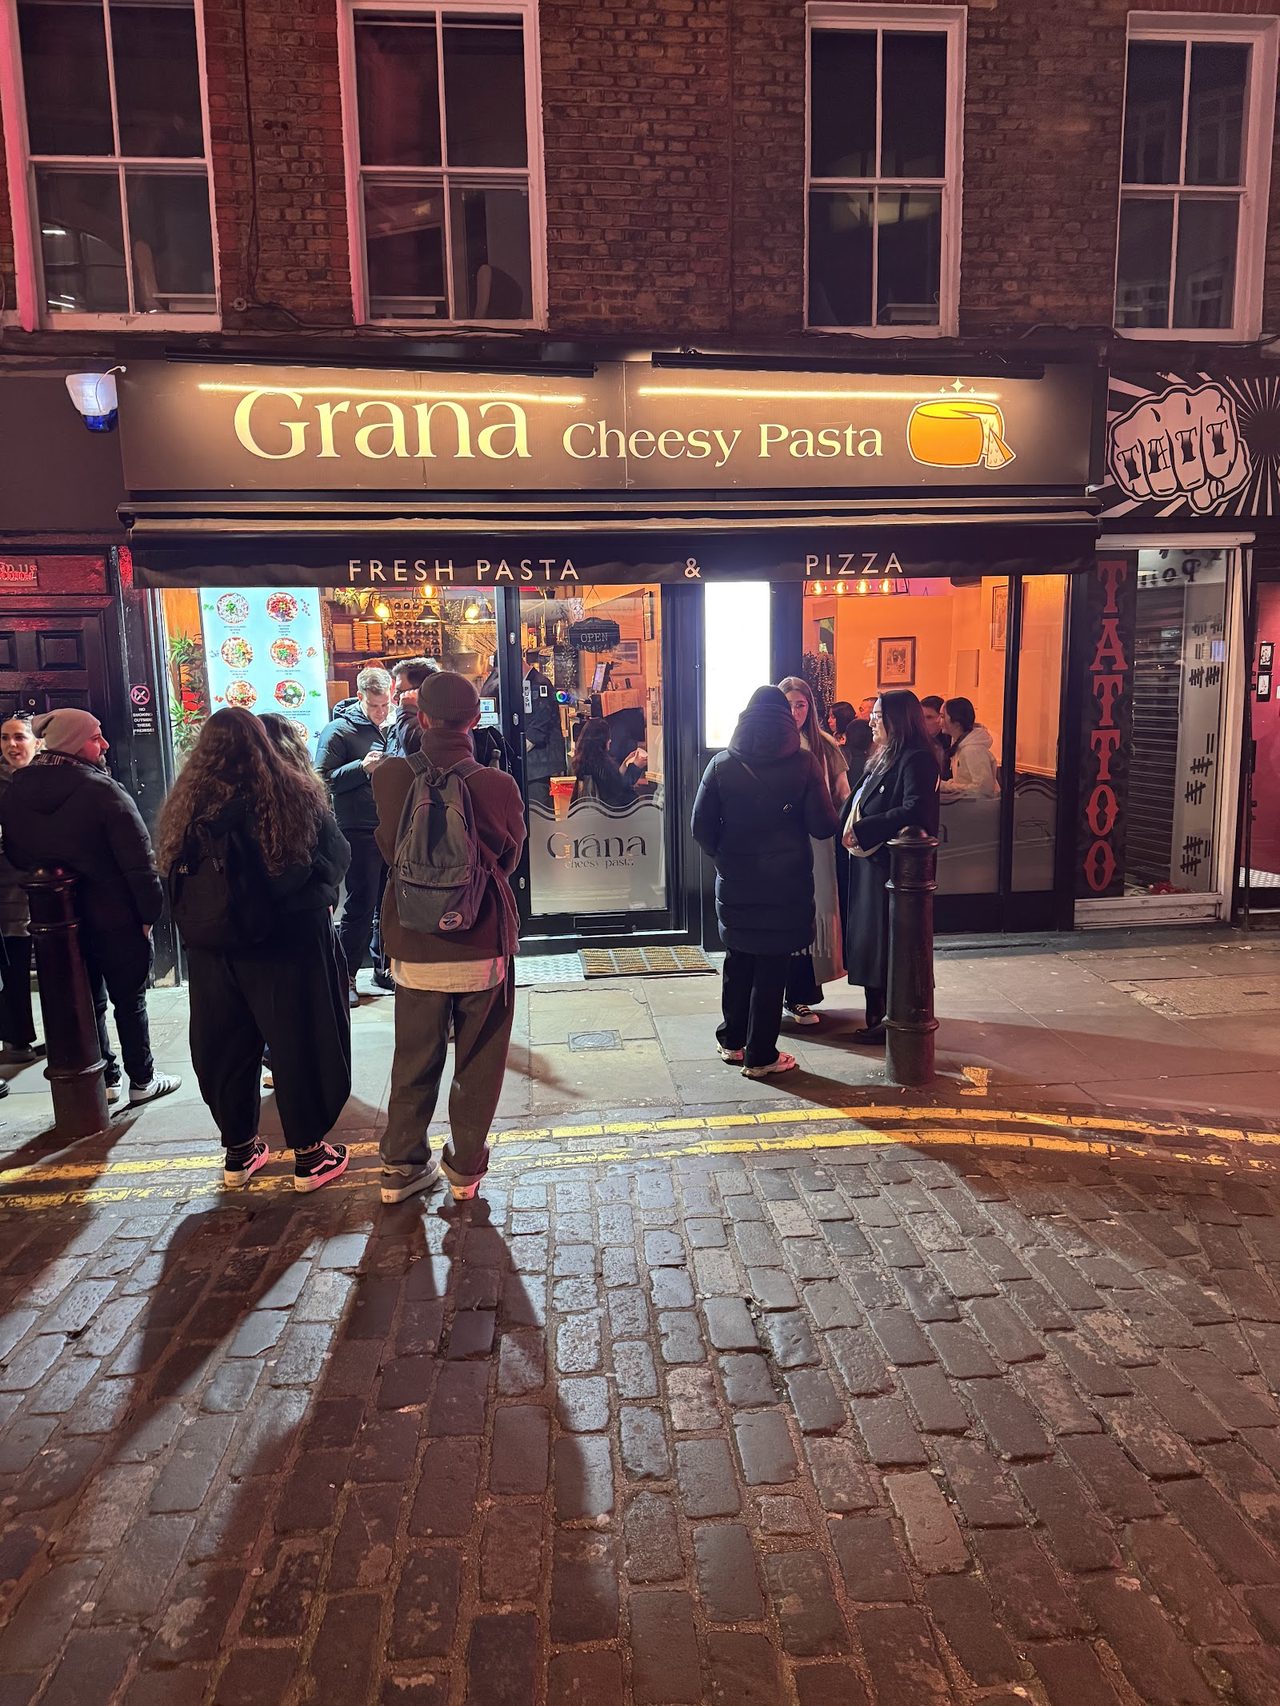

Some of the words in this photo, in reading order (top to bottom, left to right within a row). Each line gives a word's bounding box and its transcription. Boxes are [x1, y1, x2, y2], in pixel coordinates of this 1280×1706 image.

[234, 389, 533, 460] Grana
[562, 420, 743, 468] Cheesy
[757, 423, 884, 458] Pasta
[348, 559, 454, 582] FRESH
[476, 559, 580, 582] PASTA
[684, 557, 702, 578] &
[805, 552, 904, 576] PIZZA
[580, 632, 608, 643] OPEN
[1083, 560, 1129, 892] TATTOO
[546, 831, 647, 860] Grana
